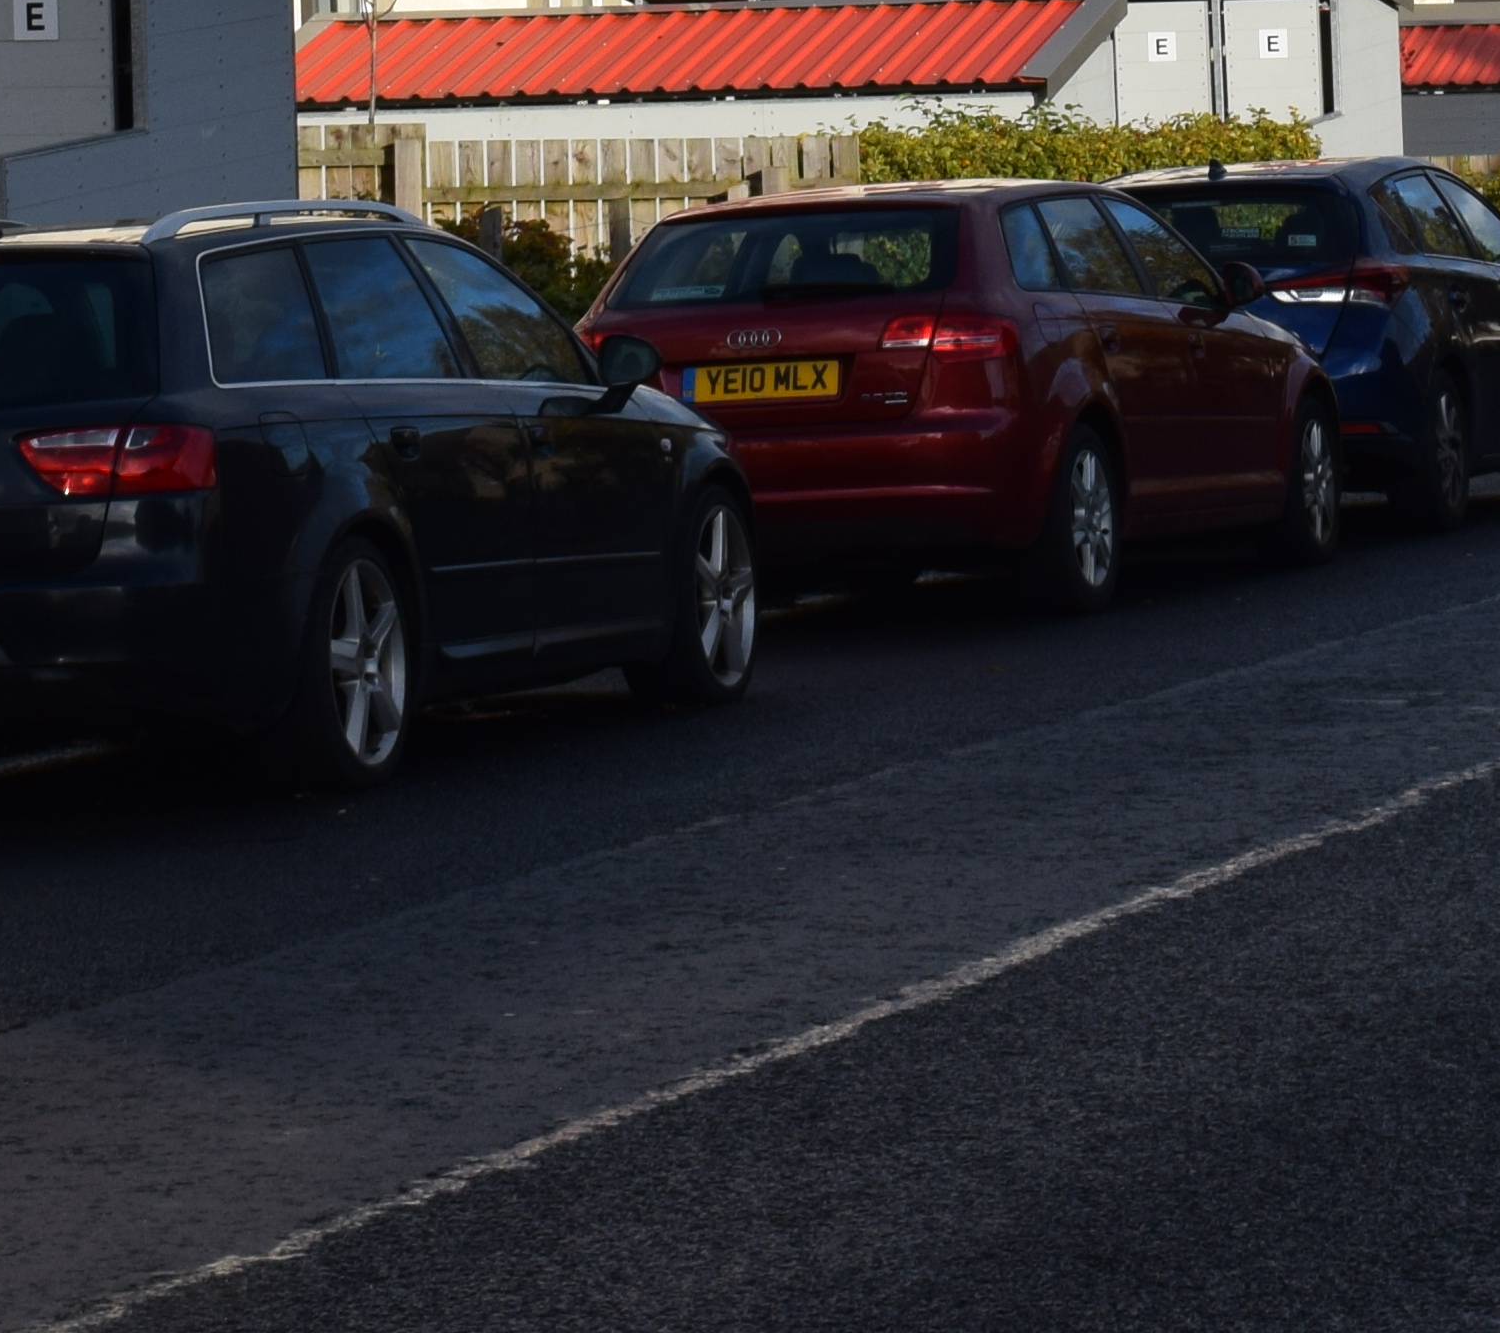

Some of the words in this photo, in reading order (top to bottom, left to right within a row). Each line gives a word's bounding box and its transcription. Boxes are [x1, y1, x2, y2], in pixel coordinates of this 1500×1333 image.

[26, 2, 46, 31] E
[1156, 38, 1168, 55] E
[1267, 35, 1280, 52] E
[706, 367, 766, 394] YE10
[773, 363, 829, 391] MLX
